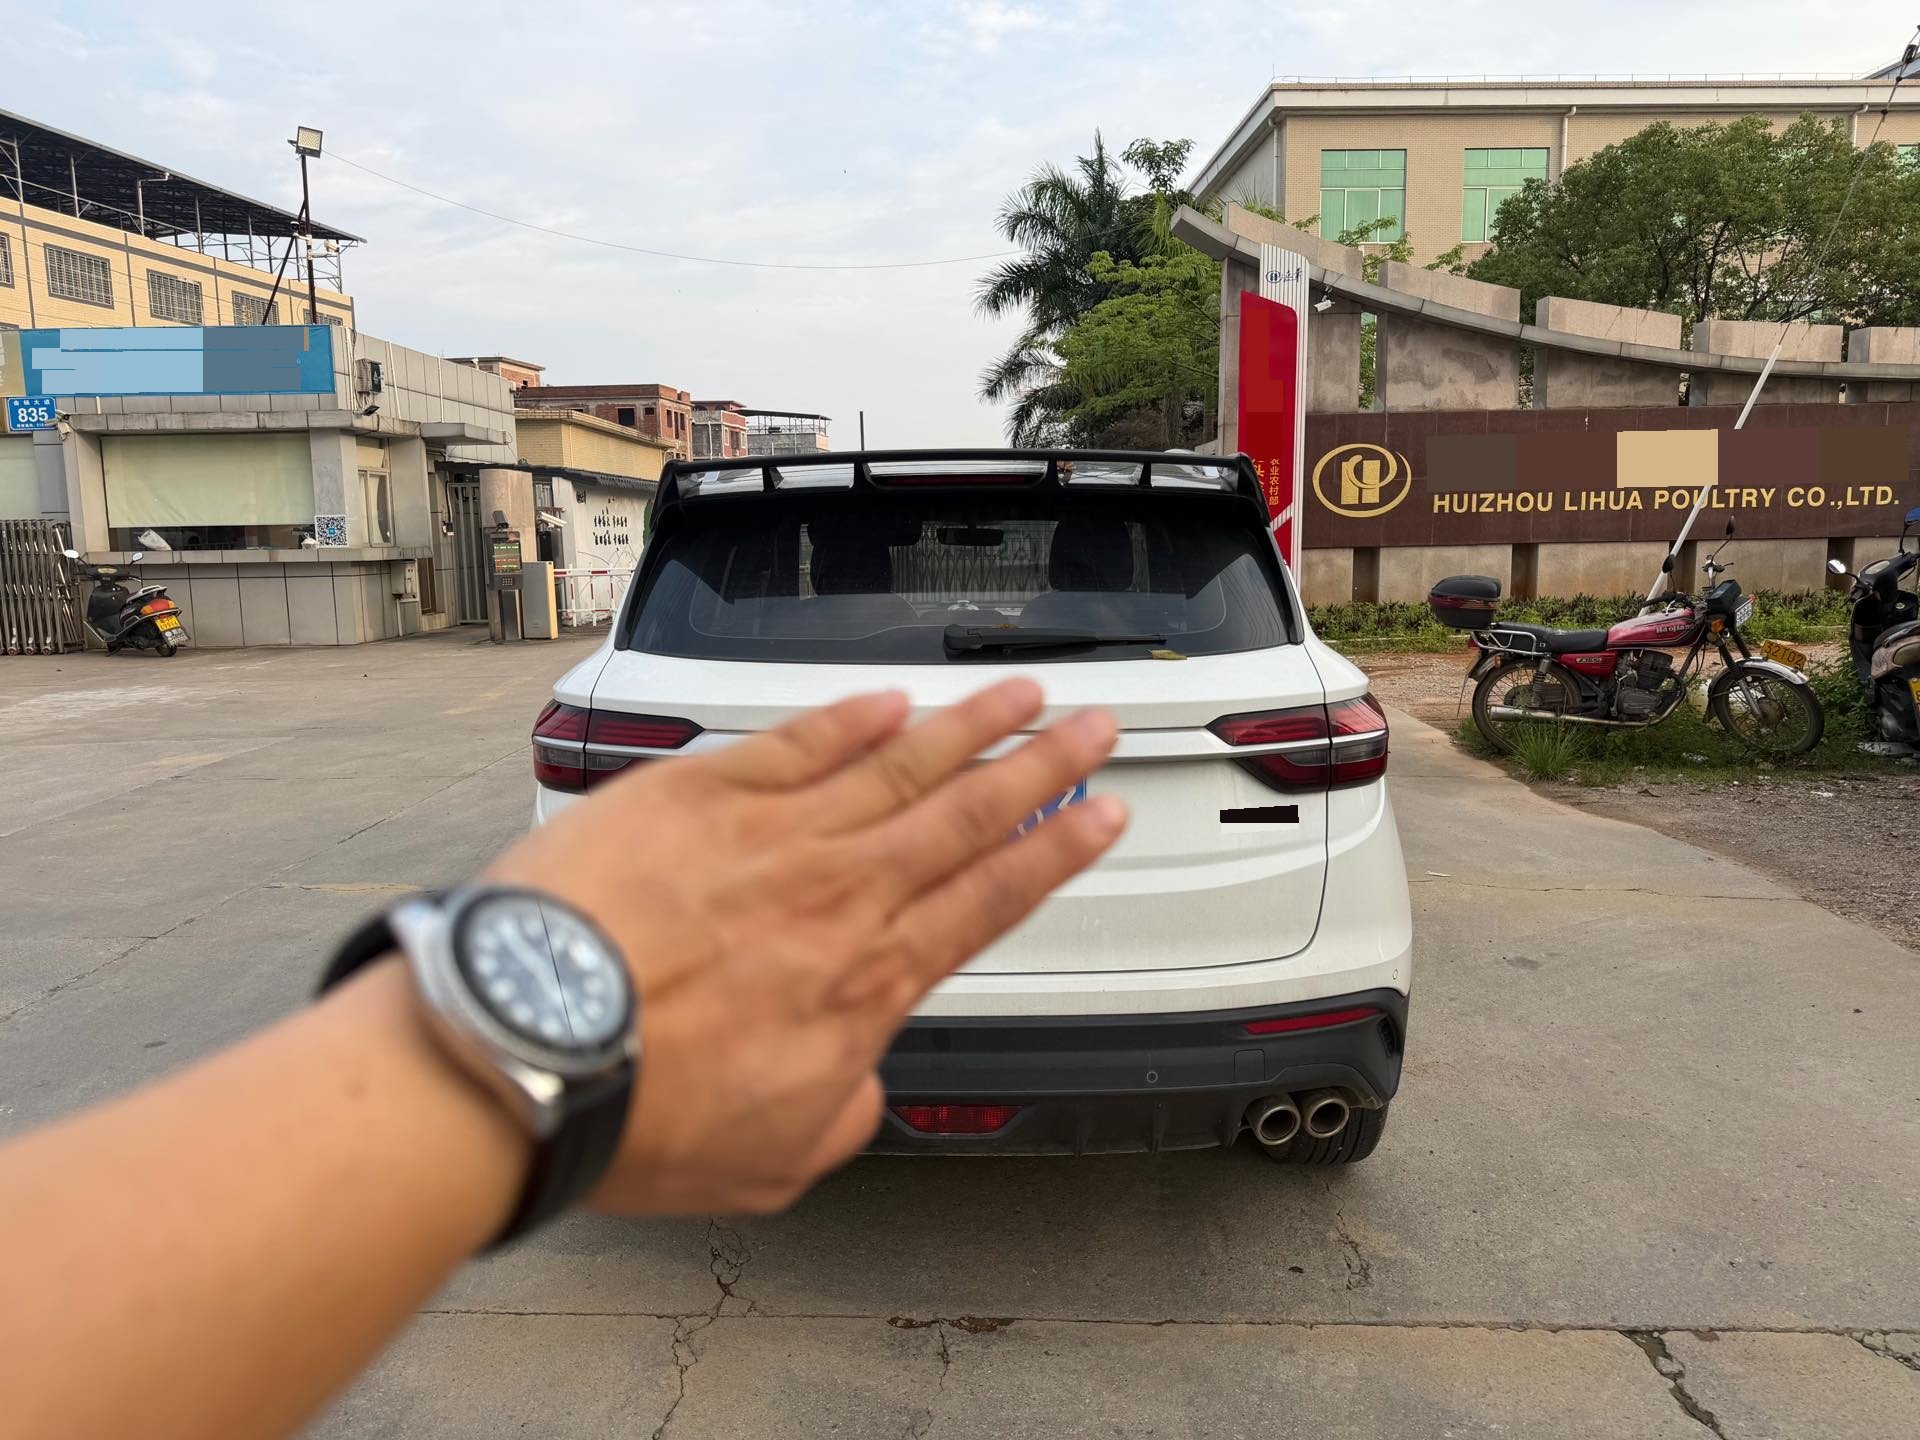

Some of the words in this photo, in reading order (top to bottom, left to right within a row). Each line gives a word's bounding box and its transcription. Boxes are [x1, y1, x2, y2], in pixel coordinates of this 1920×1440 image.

[17, 407, 49, 422] 835
[1432, 491, 1553, 514] HUIZHOU
[1563, 489, 1644, 512] LIHUA
